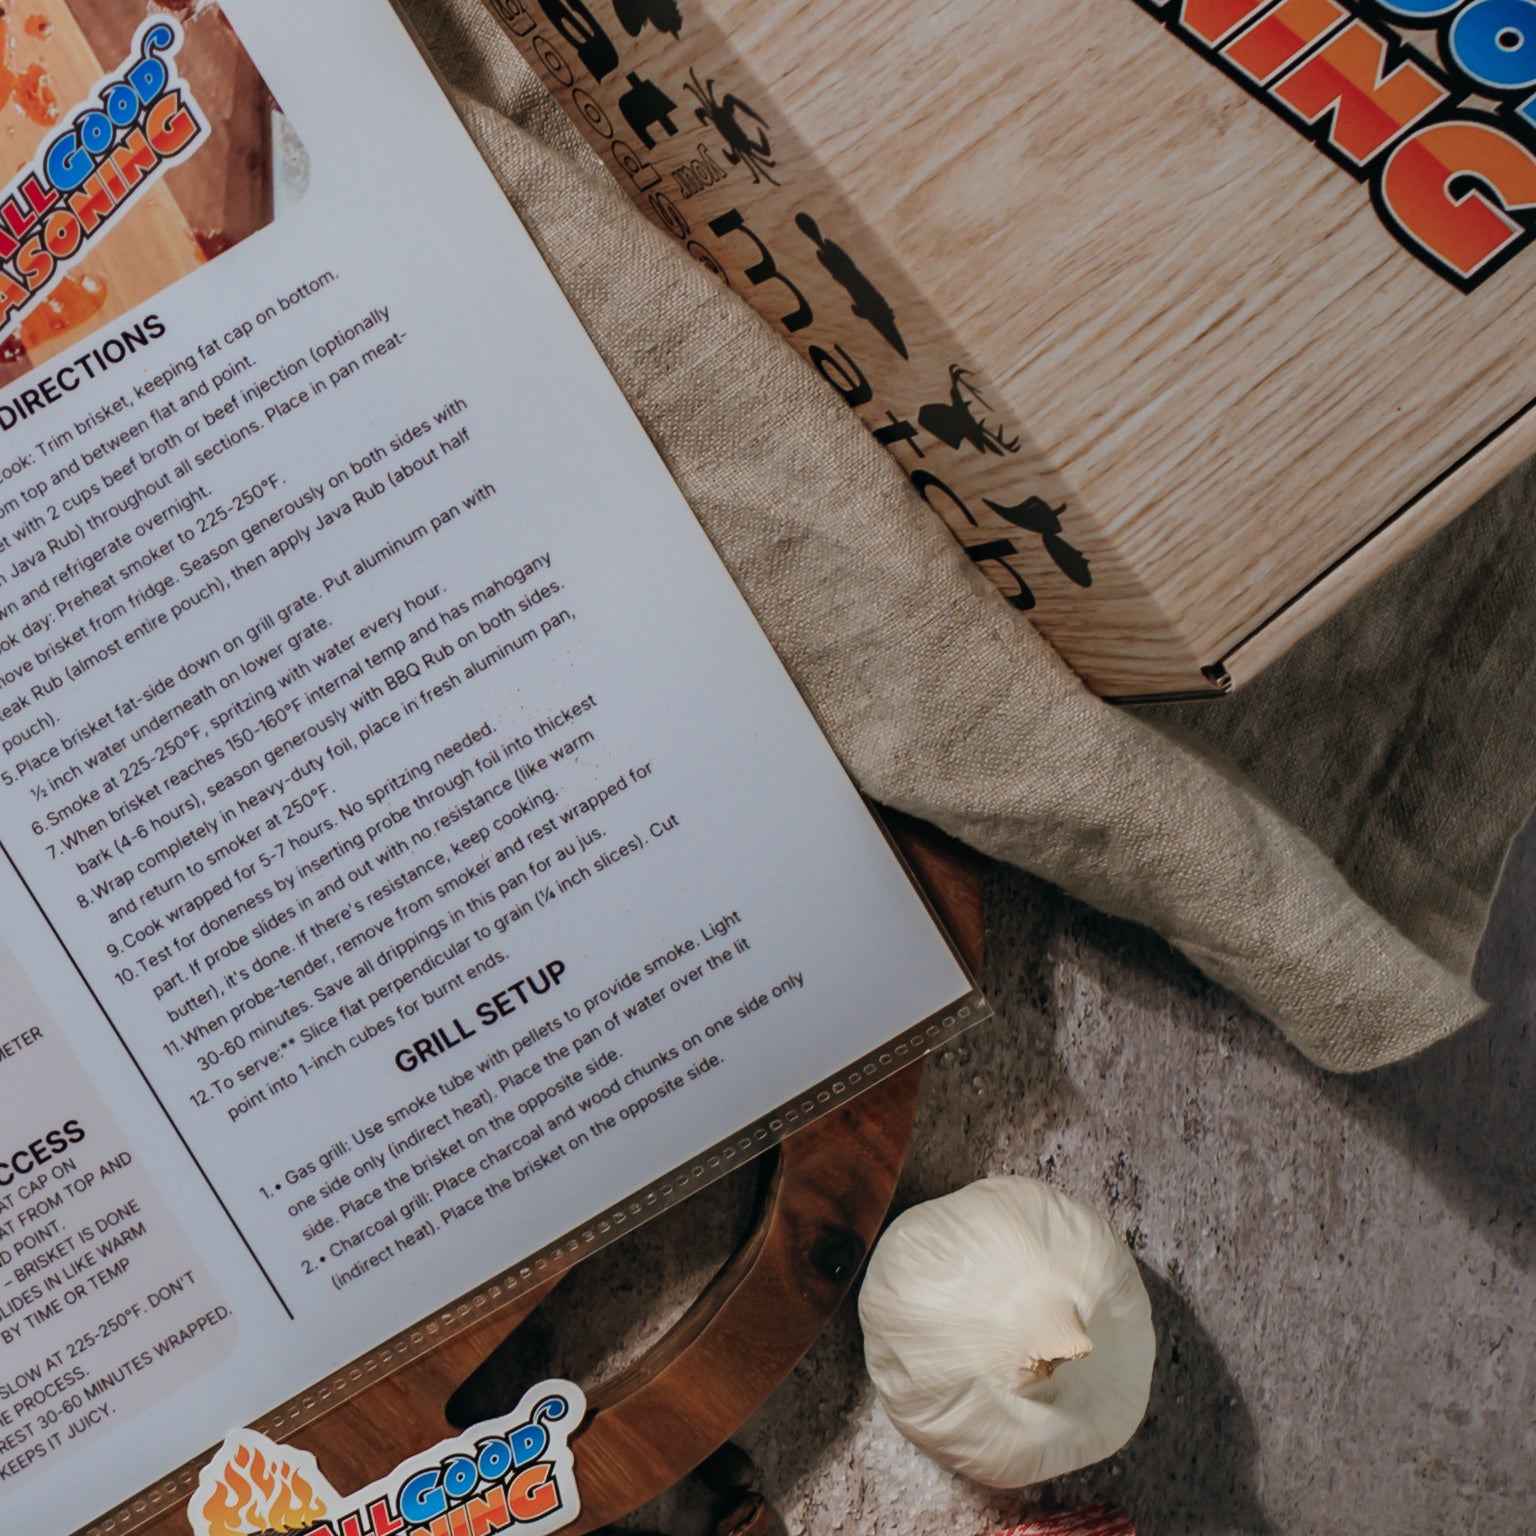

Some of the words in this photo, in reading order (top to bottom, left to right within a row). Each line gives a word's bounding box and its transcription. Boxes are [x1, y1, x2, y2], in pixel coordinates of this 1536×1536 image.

[671, 143, 728, 199] your
[107, 897, 138, 924] and
[138, 872, 185, 905] return
[185, 861, 204, 876] to
[205, 824, 261, 865] smoker
[265, 813, 282, 830] at
[227, 1089, 267, 1122] point
[267, 1072, 297, 1095] into
[297, 1044, 346, 1075] 1-inch
[348, 1015, 396, 1048] cubes
[395, 999, 419, 1019] for
[420, 973, 465, 1005] burnt
[466, 951, 509, 979] ends.
[394, 1018, 476, 1072] GRILL
[475, 959, 565, 1025] SETUP
